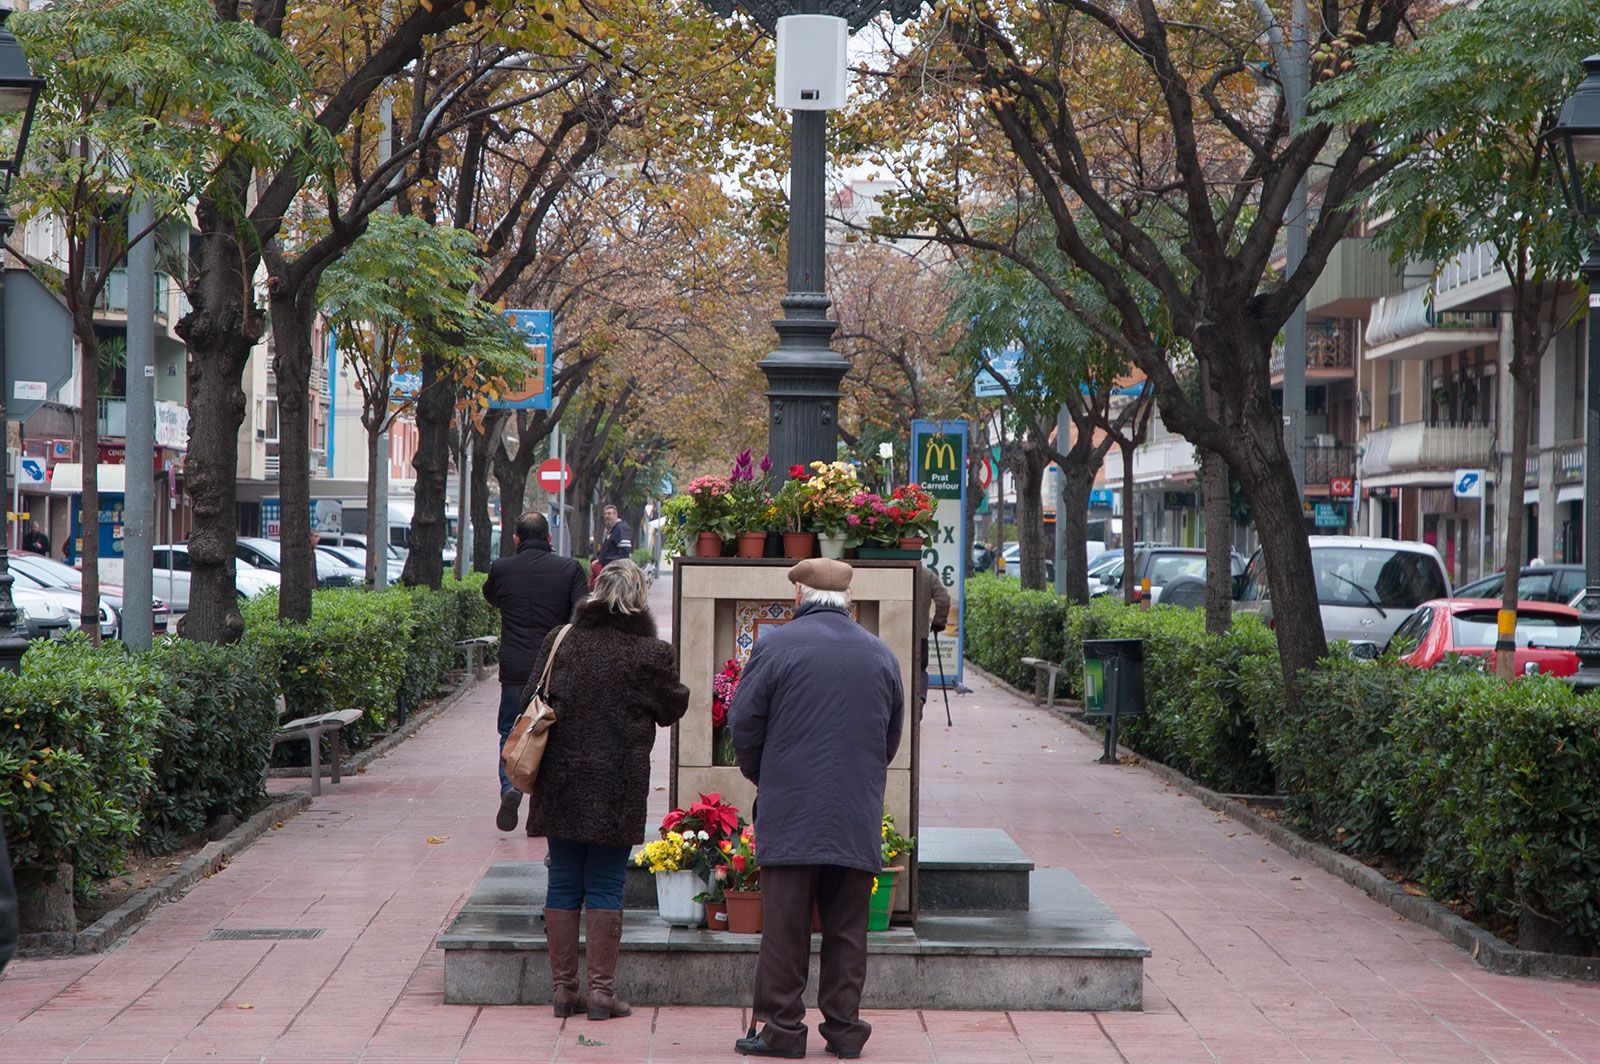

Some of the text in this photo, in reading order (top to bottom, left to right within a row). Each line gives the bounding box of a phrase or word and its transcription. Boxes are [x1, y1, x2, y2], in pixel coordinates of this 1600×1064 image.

[921, 482, 959, 490] Carrefour
[1333, 480, 1351, 493] CX
[268, 525, 280, 534] BI
